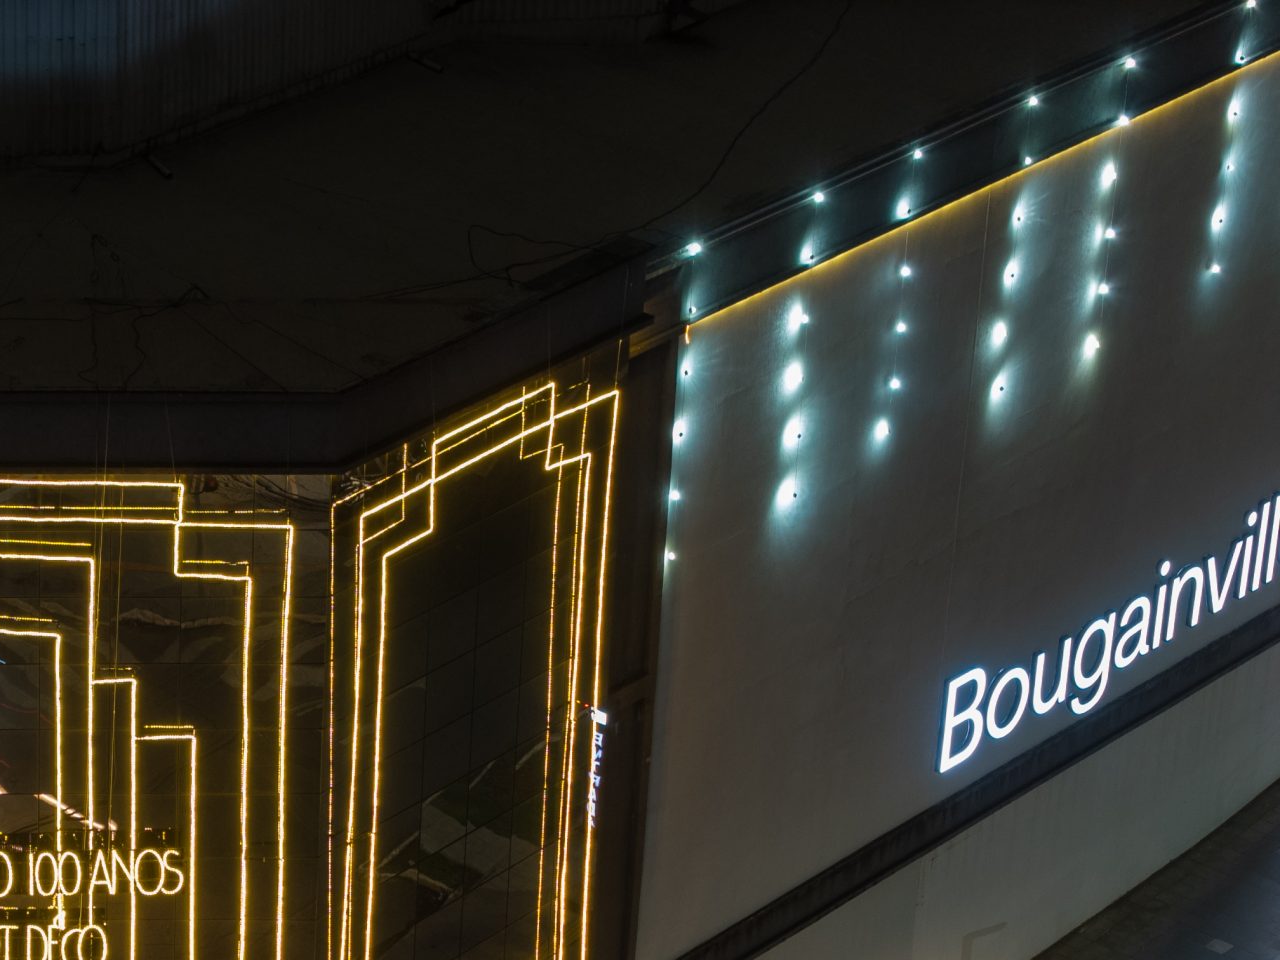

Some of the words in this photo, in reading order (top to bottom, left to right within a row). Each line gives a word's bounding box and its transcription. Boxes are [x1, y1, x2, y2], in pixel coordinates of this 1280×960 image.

[938, 495, 1280, 774] Bougainvill
[29, 851, 82, 897] 100
[89, 849, 184, 896] ANOS
